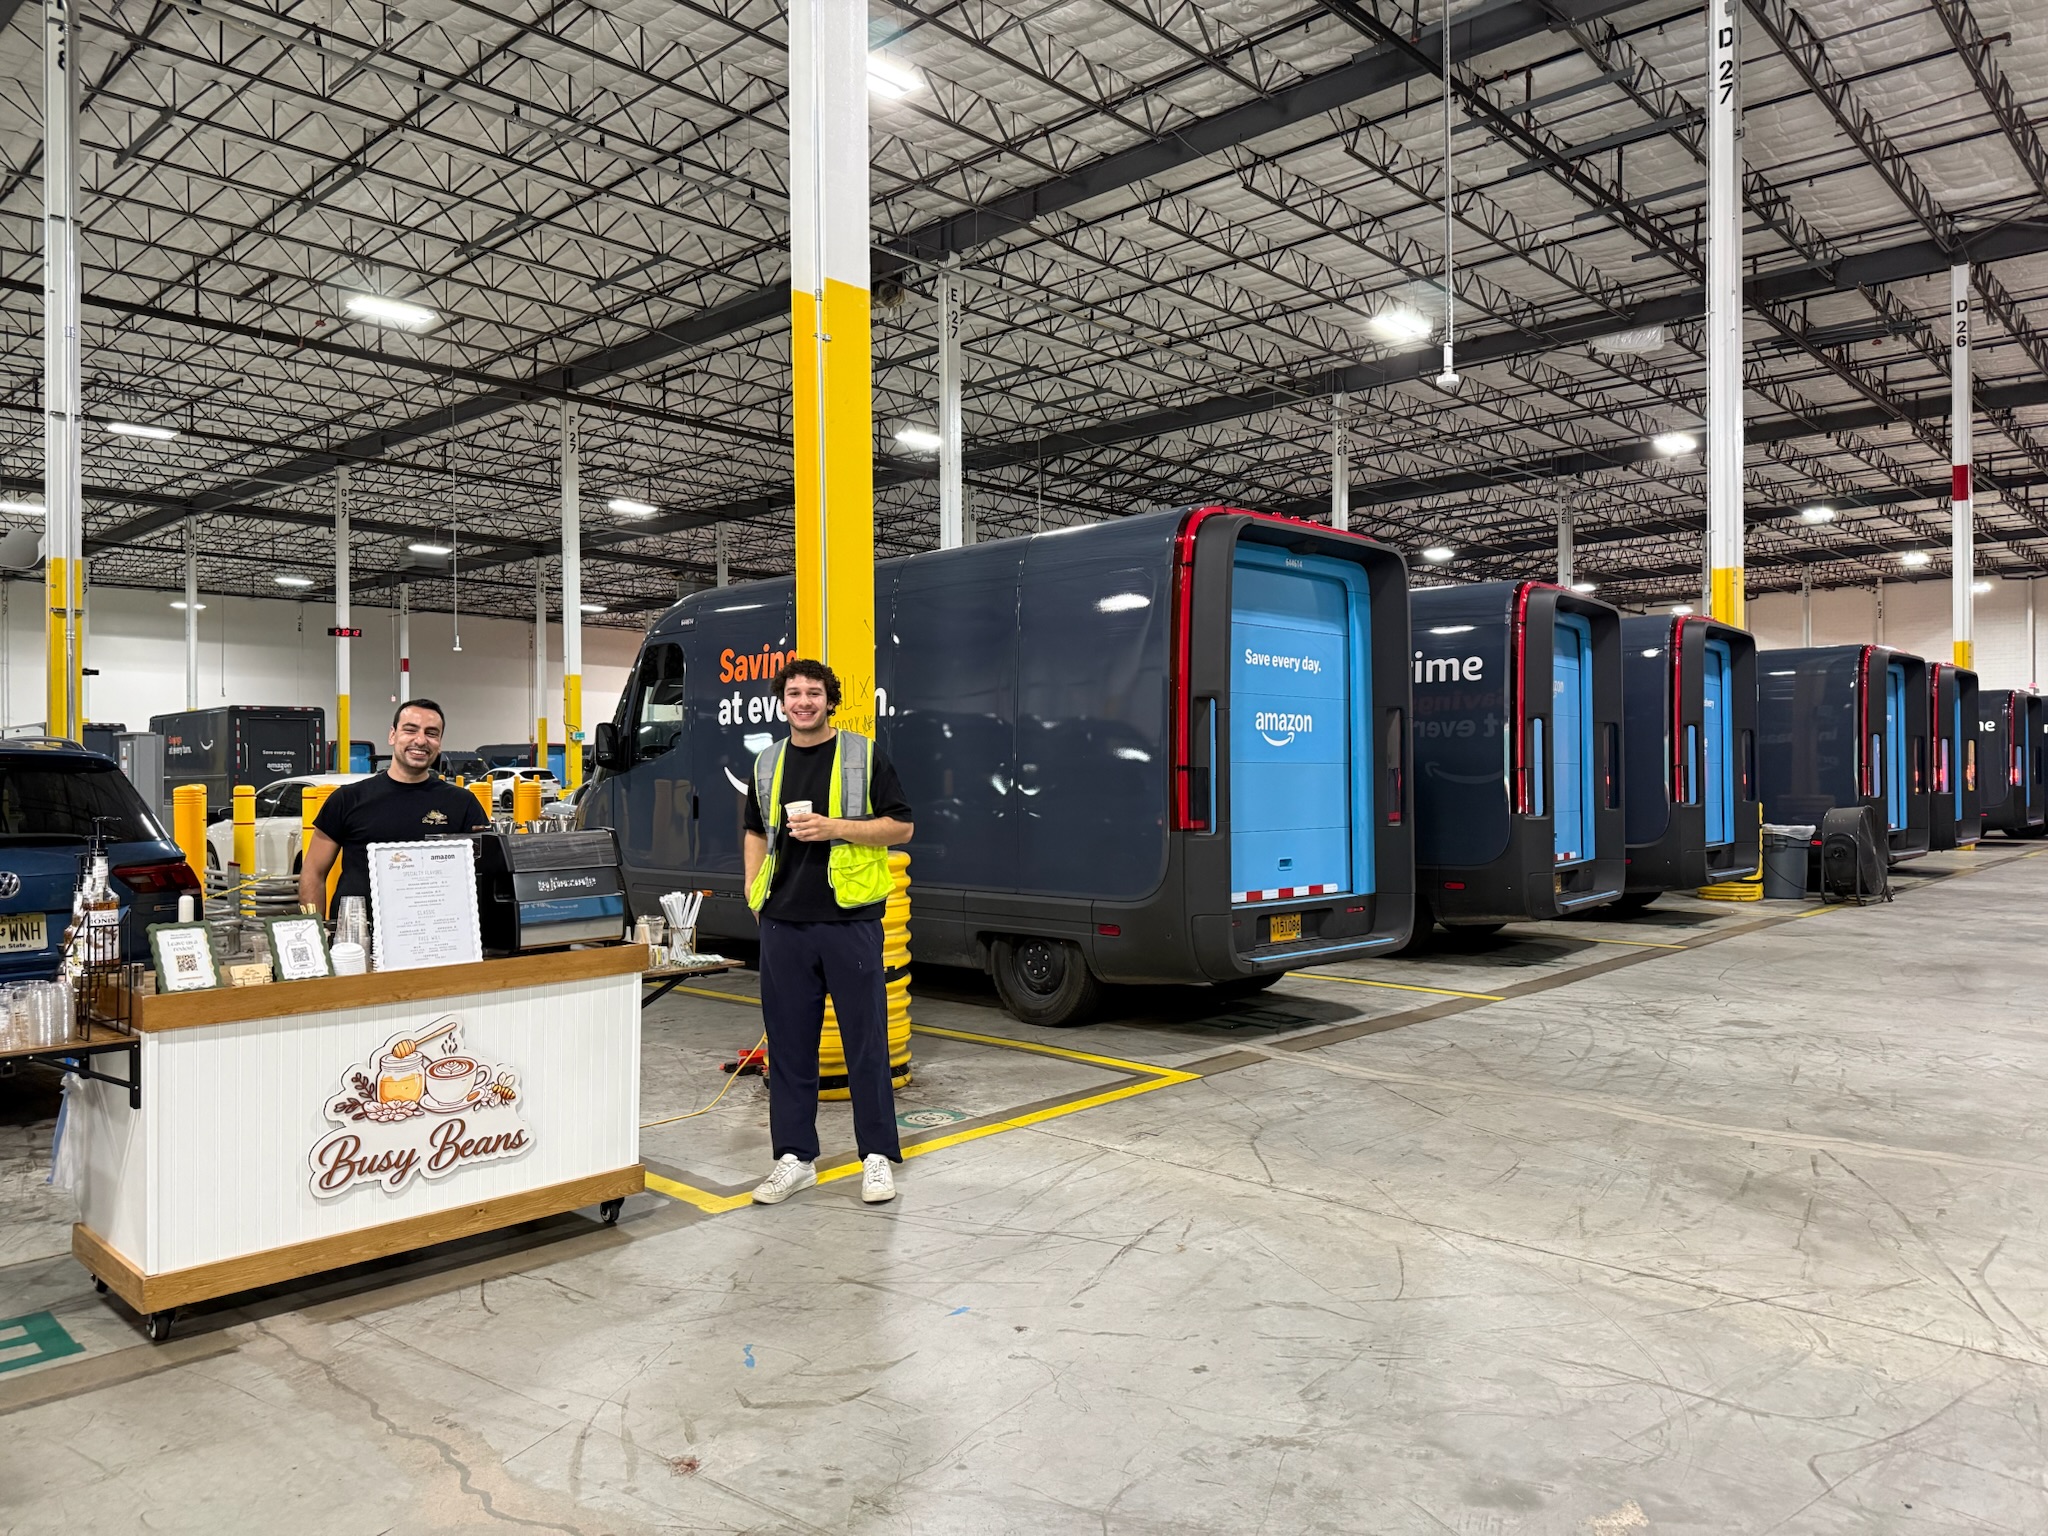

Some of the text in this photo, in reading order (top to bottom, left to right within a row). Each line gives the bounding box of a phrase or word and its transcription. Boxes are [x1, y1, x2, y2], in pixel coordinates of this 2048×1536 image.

[1718, 27, 1733, 105] D 27
[950, 288, 958, 339] E 27
[1956, 300, 1968, 348] D 26
[569, 416, 577, 454] F 27
[341, 488, 347, 497] G
[1245, 648, 1321, 675] Save every day.
[1410, 650, 1484, 684] ime
[717, 690, 789, 726] at eve
[1255, 711, 1313, 733] amazon
[430, 853, 456, 861] amazon
[318, 1118, 530, 1190] Busy Beans
